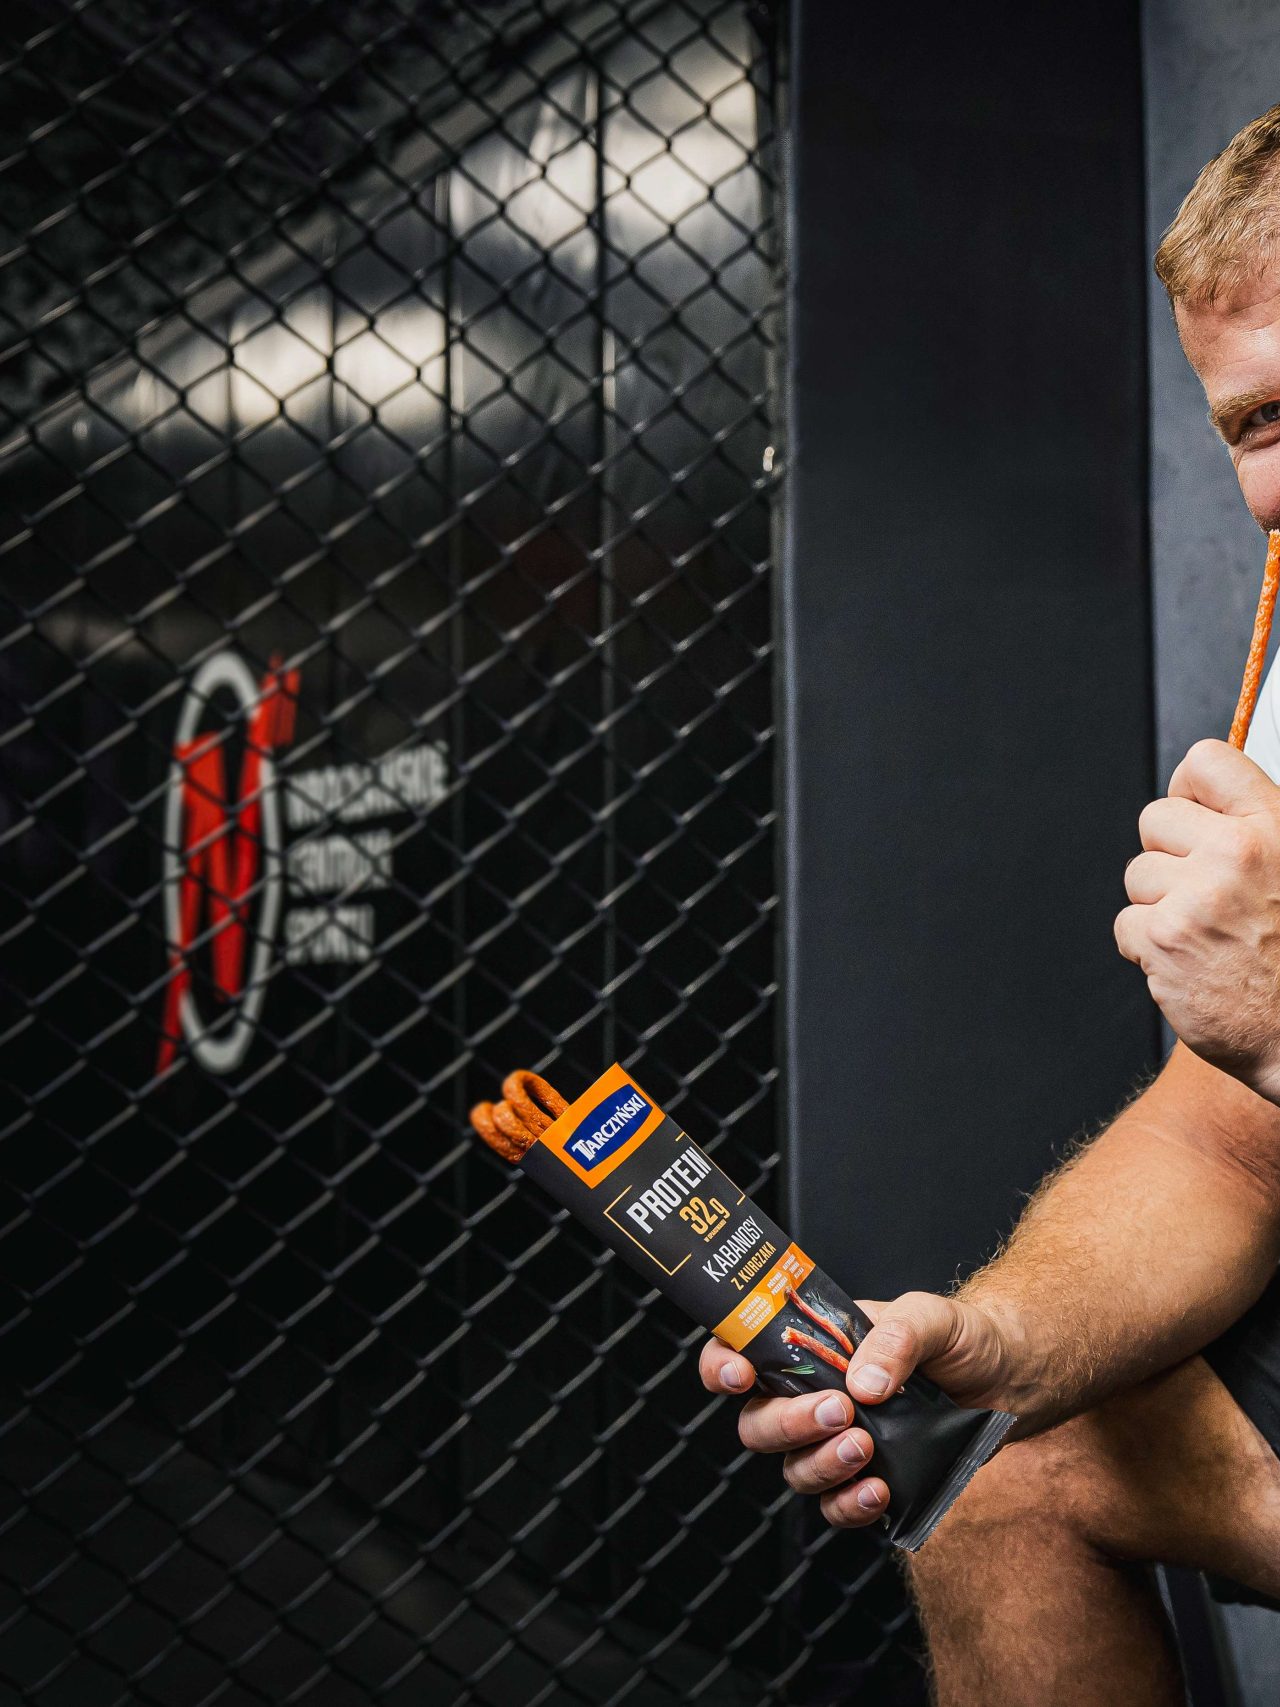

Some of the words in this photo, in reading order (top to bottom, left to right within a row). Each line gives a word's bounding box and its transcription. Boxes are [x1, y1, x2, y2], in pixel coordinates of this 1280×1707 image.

[571, 1093, 648, 1162] TARCZYŃSKI
[625, 1146, 713, 1235] PROTEIN
[679, 1196, 731, 1235] 32g
[701, 1215, 764, 1283] KABANOSY
[737, 1241, 777, 1283] KURCZAKA
[730, 1276, 745, 1291] Z
